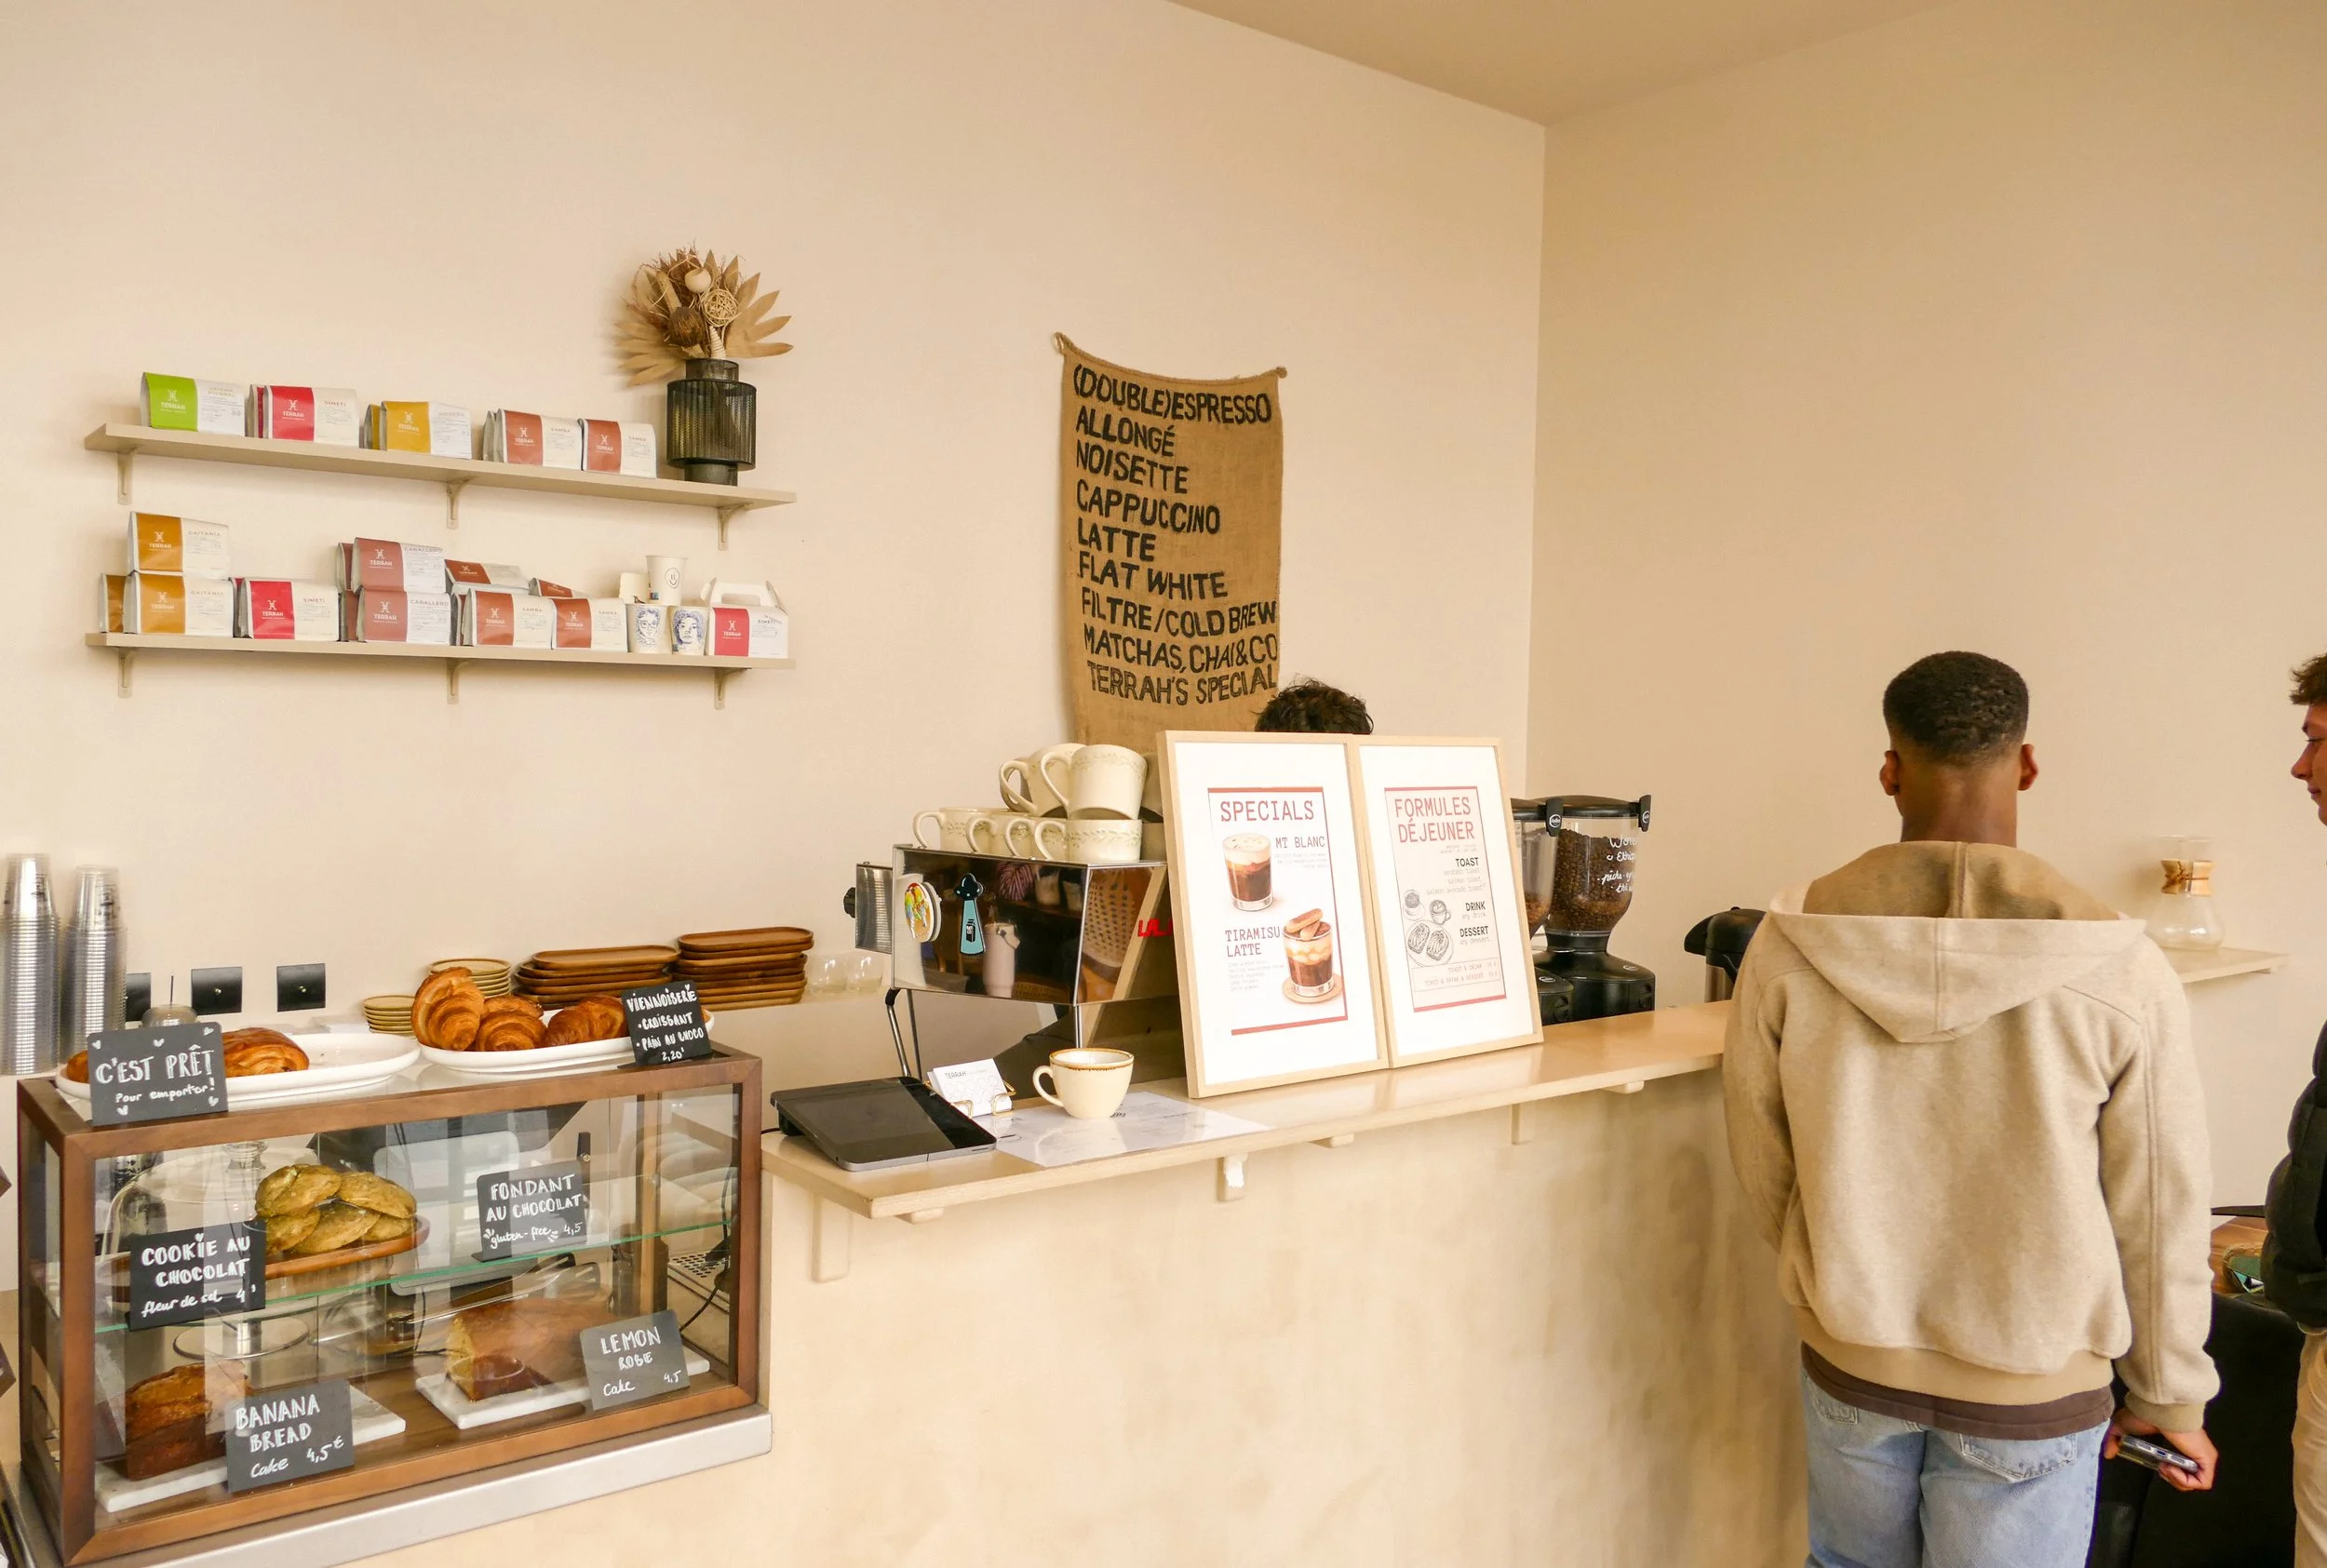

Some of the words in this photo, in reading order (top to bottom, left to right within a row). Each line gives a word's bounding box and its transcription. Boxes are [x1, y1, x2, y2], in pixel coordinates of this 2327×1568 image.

[1075, 406, 1176, 457] ALLONGÉ
[1076, 439, 1190, 493] NOISETTE
[1076, 479, 1220, 534] CAPPUCCINO
[1078, 517, 1156, 561] LATTE
[1079, 551, 1139, 589] FLAT
[1147, 568, 1228, 600] WHITE
[1229, 600, 1276, 634] BREW
[1087, 661, 1189, 705] TERRAH'S
[1195, 663, 1278, 704] SPECIAL
[1220, 800, 1314, 822] SPECIALS
[1394, 797, 1471, 818] FORMULES
[1275, 837, 1288, 849] MT
[1294, 836, 1325, 848] BLANC
[1398, 818, 1475, 843] DÉJEUNER
[1455, 857, 1479, 867] TOAST
[1465, 901, 1486, 912] DRINK
[1225, 926, 1281, 943] TIRAMISU
[1459, 925, 1489, 938] DESSERT
[1227, 944, 1262, 958] LATTE
[665, 1033, 676, 1045] AU
[678, 1026, 704, 1041] CHOCO
[95, 1055, 155, 1084] C'EST
[164, 1043, 215, 1079] PRÊT
[944, 1070, 967, 1079] TERRAH
[491, 1173, 575, 1200] FONDANT
[486, 1206, 506, 1223] AU
[512, 1194, 582, 1218] CHOCOLAT
[141, 1237, 218, 1266] COOKIE
[227, 1236, 250, 1253] AU
[155, 1257, 250, 1288] CHOCOLAT
[141, 1298, 179, 1318] fleur
[181, 1294, 198, 1308] de
[200, 1290, 222, 1303] sel
[600, 1326, 662, 1355] LEMON
[603, 1379, 636, 1396] Cake
[235, 1394, 320, 1430] BANANA
[249, 1423, 312, 1453] BREAD
[250, 1457, 289, 1479] Cake
